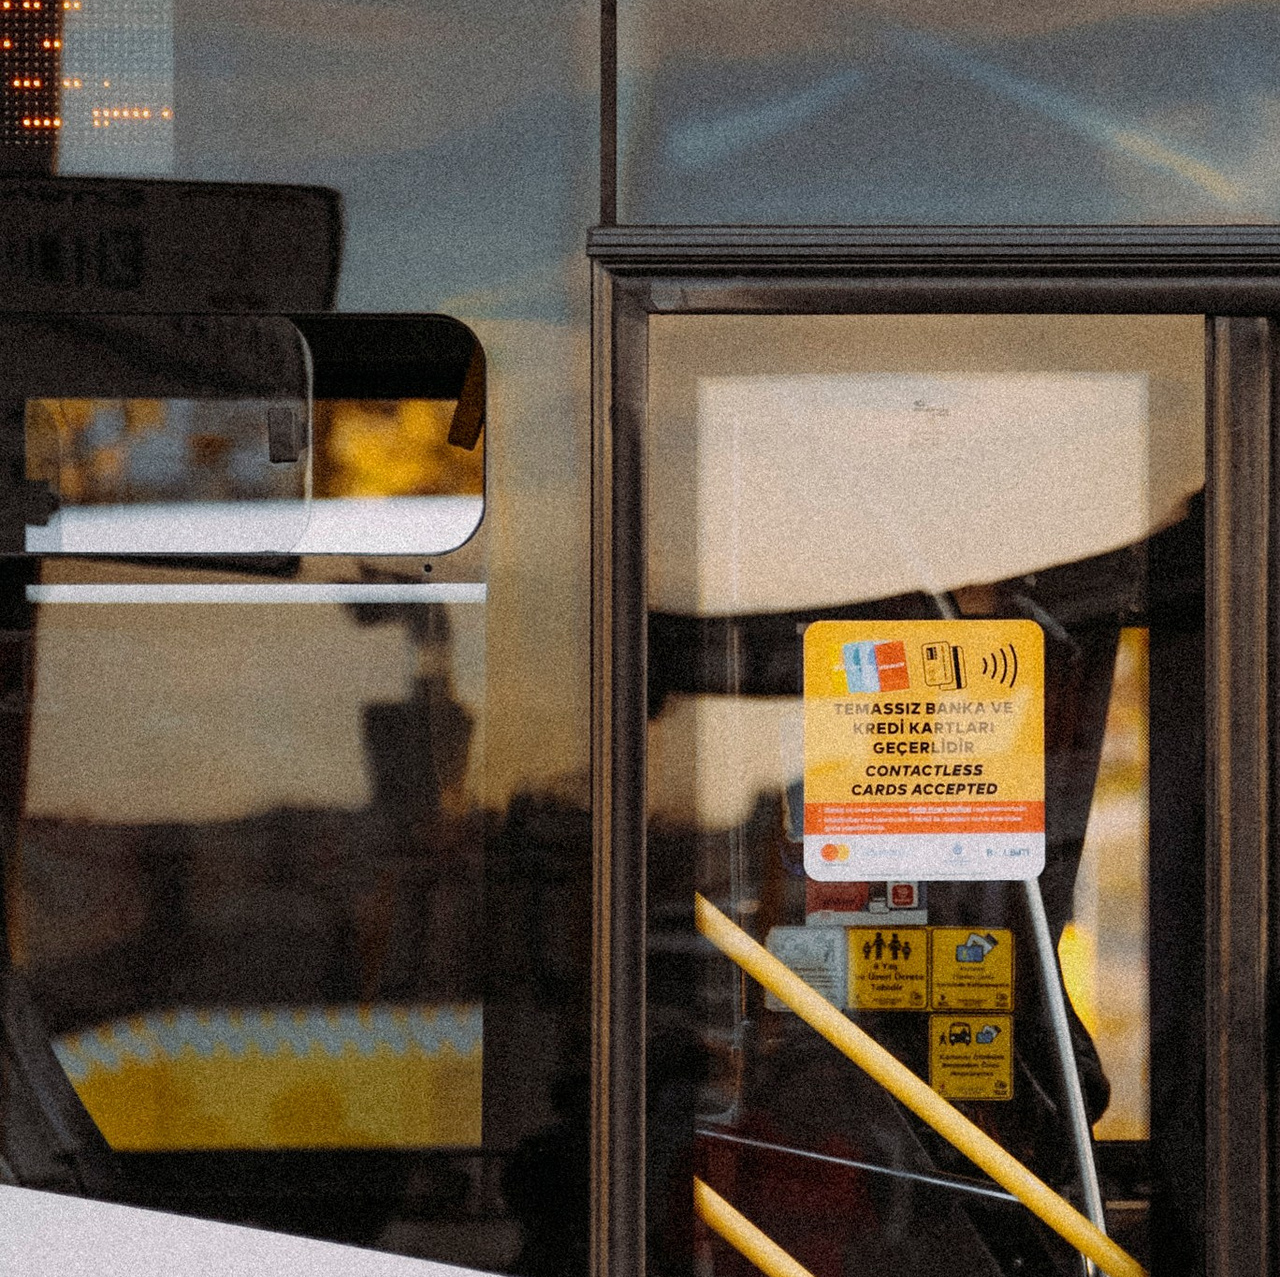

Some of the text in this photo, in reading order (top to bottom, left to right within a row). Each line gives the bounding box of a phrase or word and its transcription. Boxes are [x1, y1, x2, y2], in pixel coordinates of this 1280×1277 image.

[834, 701, 1013, 715] TEMASSIZ BANKA VE
[853, 718, 994, 735] KREDİ KARTLARI
[873, 738, 974, 757] GEÇERLİDİR
[865, 764, 984, 777] CONTACTLESS
[851, 782, 998, 796] CARDS ACCEPTED
